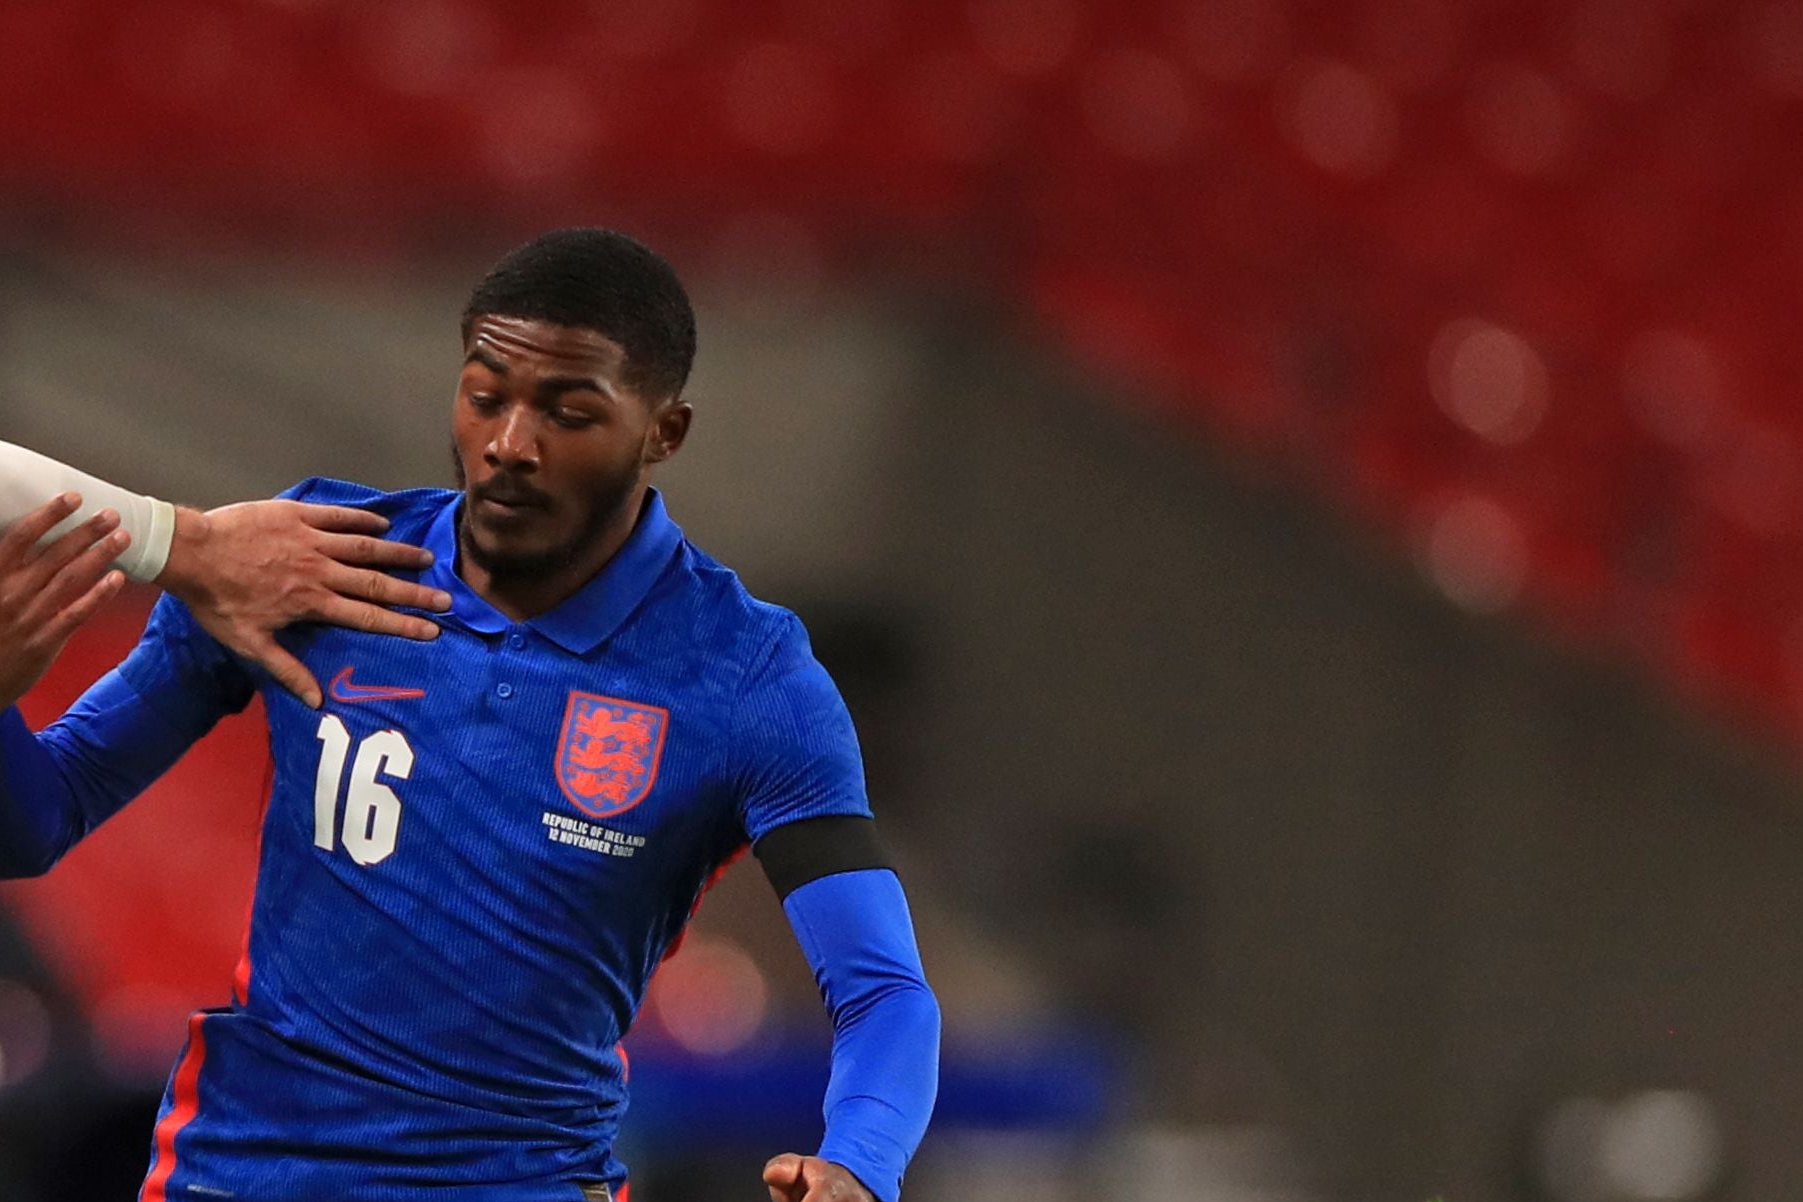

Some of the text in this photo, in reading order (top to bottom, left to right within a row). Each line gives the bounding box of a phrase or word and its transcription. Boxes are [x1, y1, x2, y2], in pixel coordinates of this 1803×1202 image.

[313, 713, 416, 866] 16
[542, 812, 646, 847] REPUBLIC OF IRELAND
[548, 827, 635, 857] 12 NOVEMBER 2020
